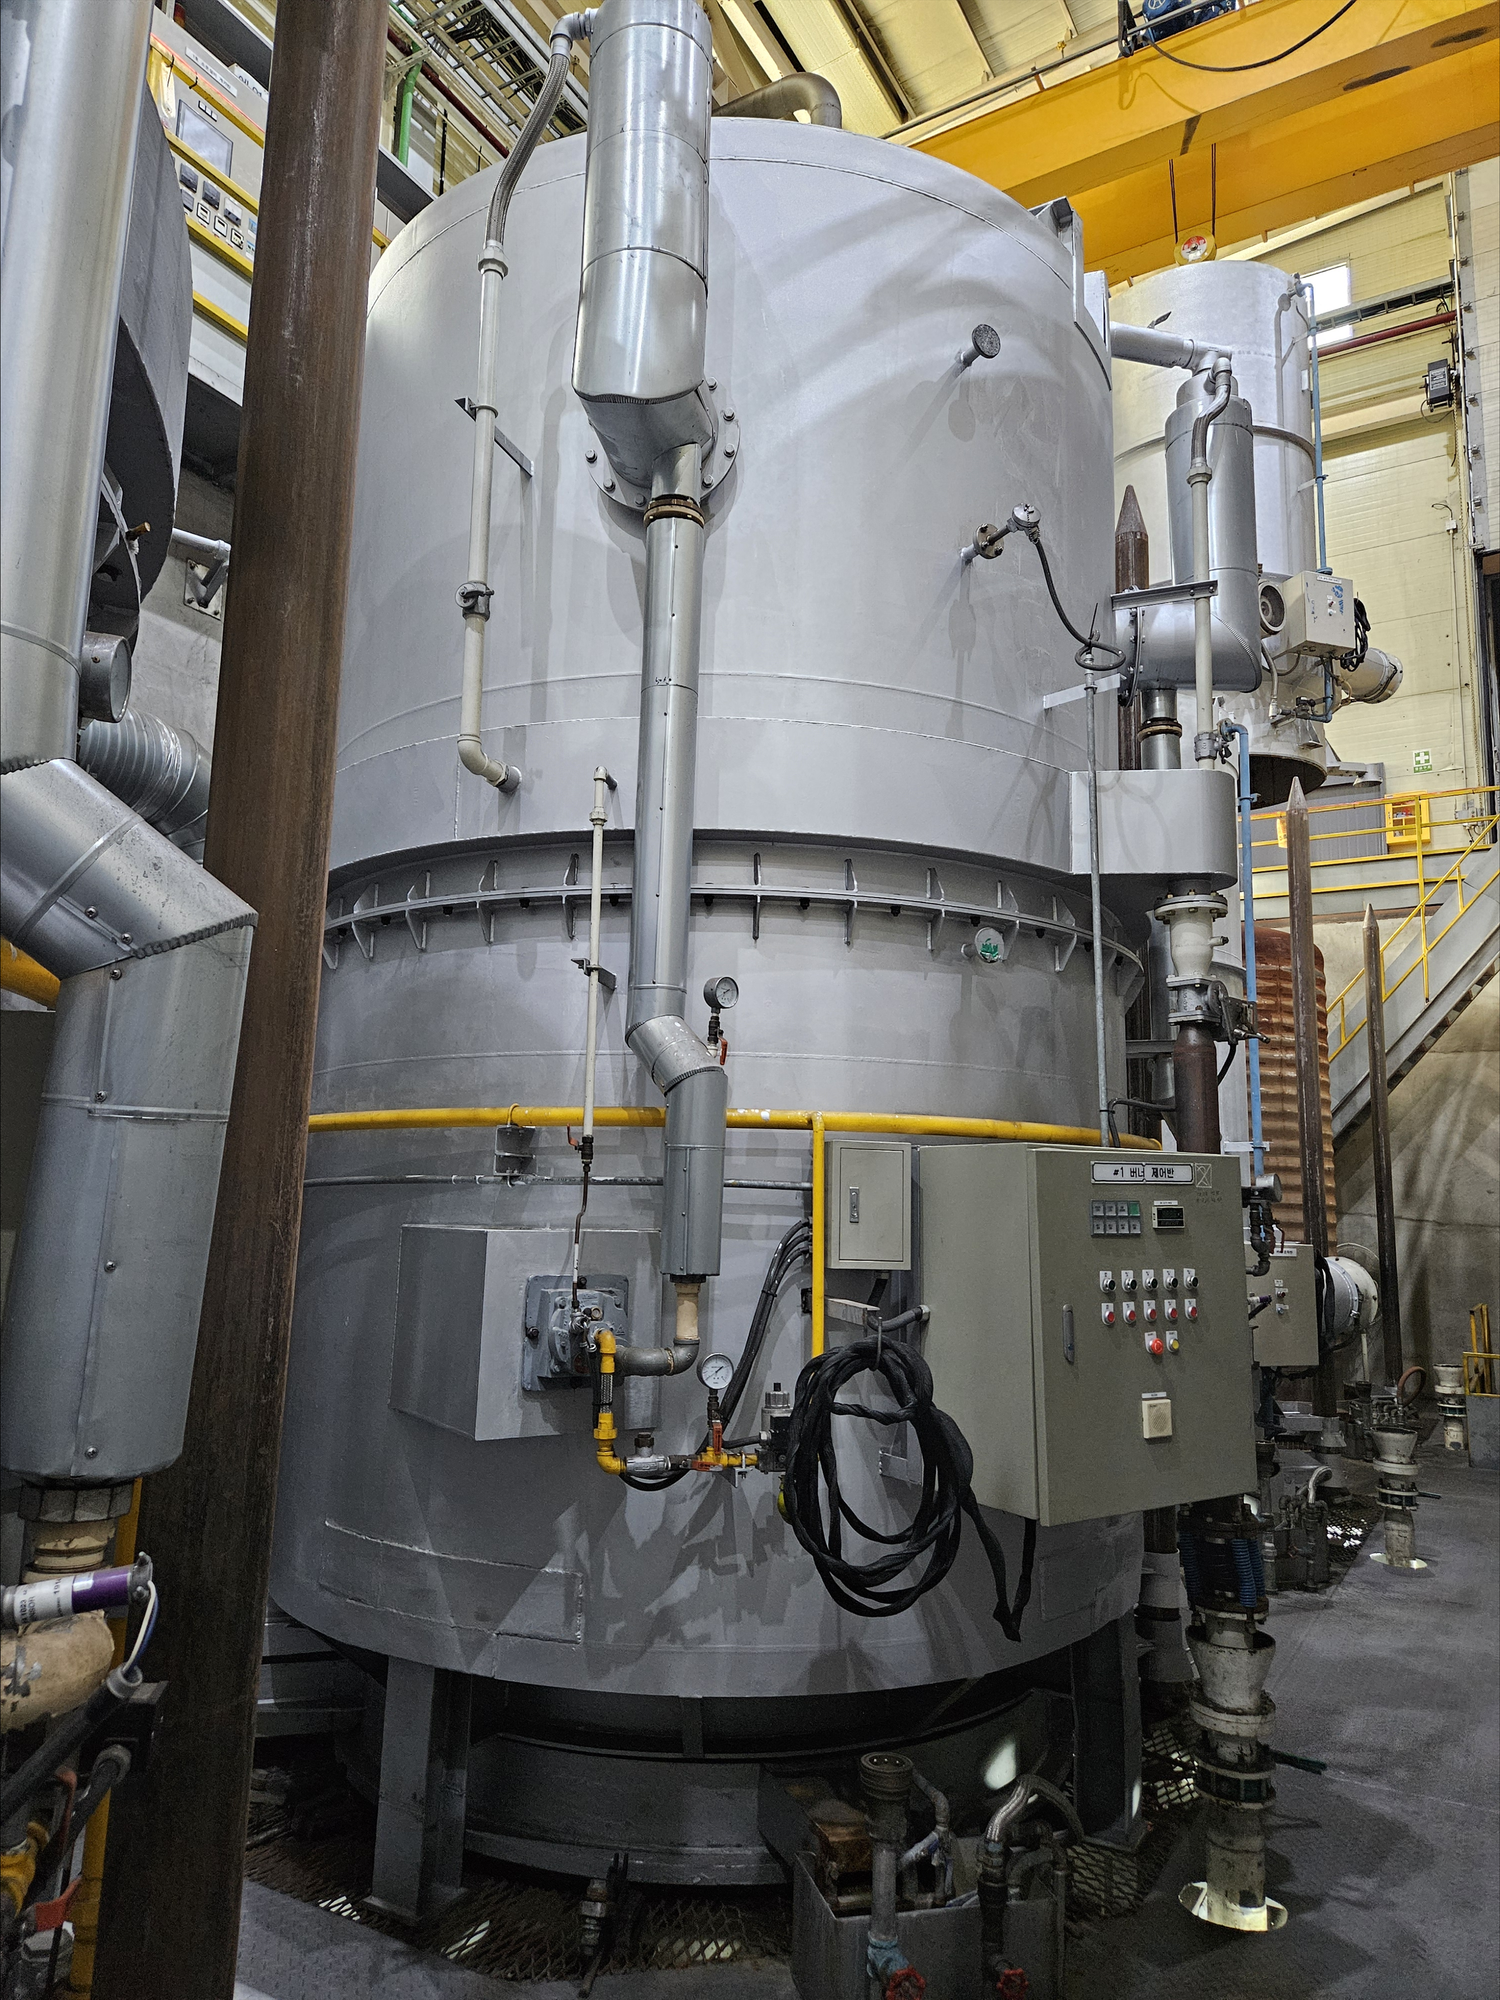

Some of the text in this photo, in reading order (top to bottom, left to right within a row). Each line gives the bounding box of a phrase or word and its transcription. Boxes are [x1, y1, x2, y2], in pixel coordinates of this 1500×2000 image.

[1113, 1167, 1175, 1179] #1 버너 제어반
